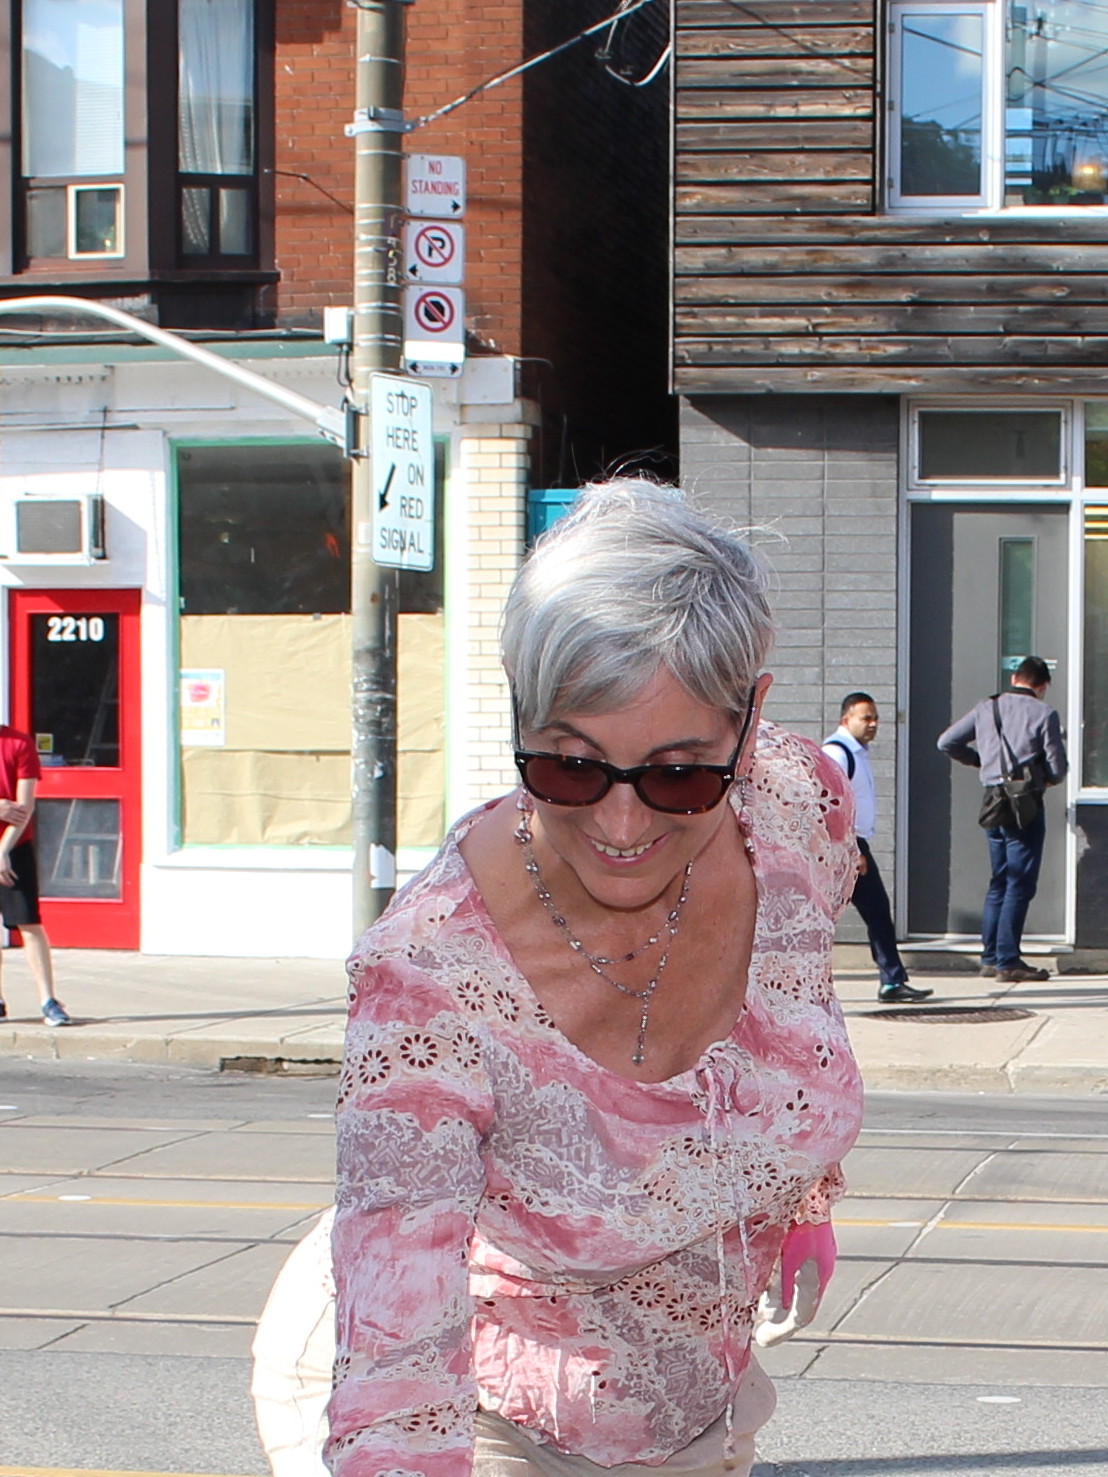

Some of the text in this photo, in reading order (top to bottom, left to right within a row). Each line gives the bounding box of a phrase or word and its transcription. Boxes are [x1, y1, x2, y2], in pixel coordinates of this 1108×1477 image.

[427, 161, 443, 176] NO
[411, 179, 461, 196] STANDING
[386, 391, 418, 418] STOP
[386, 426, 419, 452] HERE
[407, 463, 425, 487] ON
[400, 496, 424, 520] RED
[379, 527, 425, 554] SIGNAL
[47, 616, 105, 642] 2210
